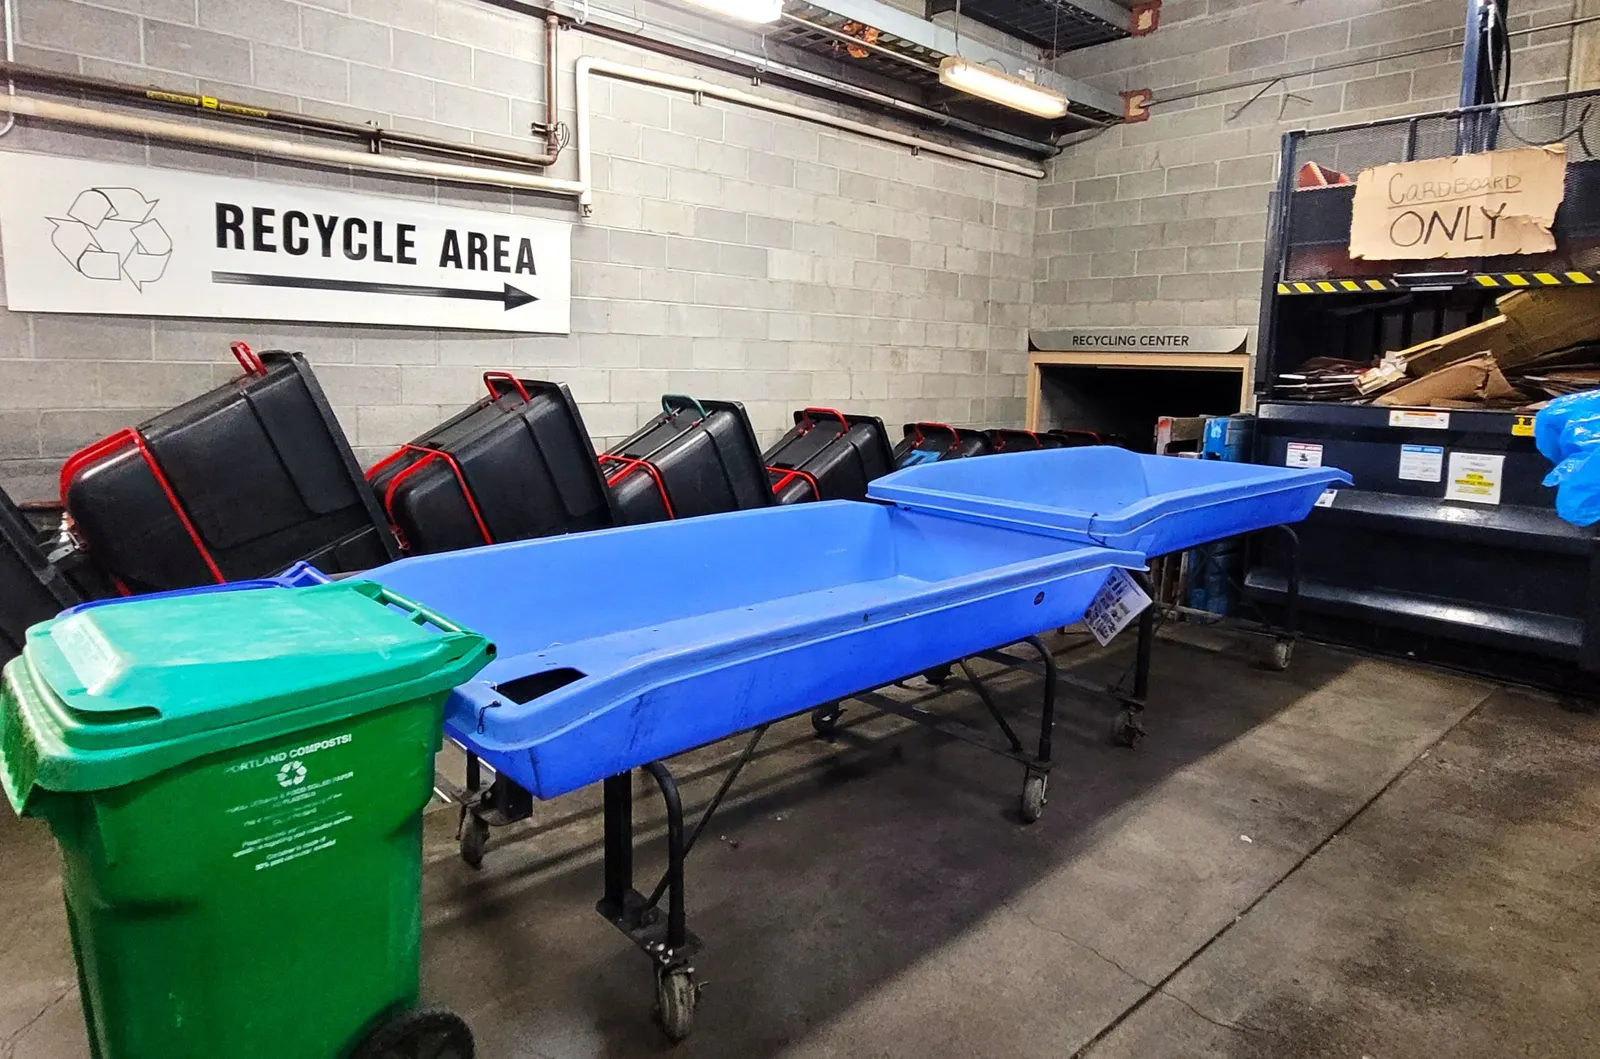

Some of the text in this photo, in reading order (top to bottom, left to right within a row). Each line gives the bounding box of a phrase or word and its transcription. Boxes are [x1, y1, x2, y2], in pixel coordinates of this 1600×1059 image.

[215, 202, 537, 276] RECYCLE AREA
[1389, 202, 1507, 247] ONLY
[1072, 335, 1190, 347] RECYCLING CENTER
